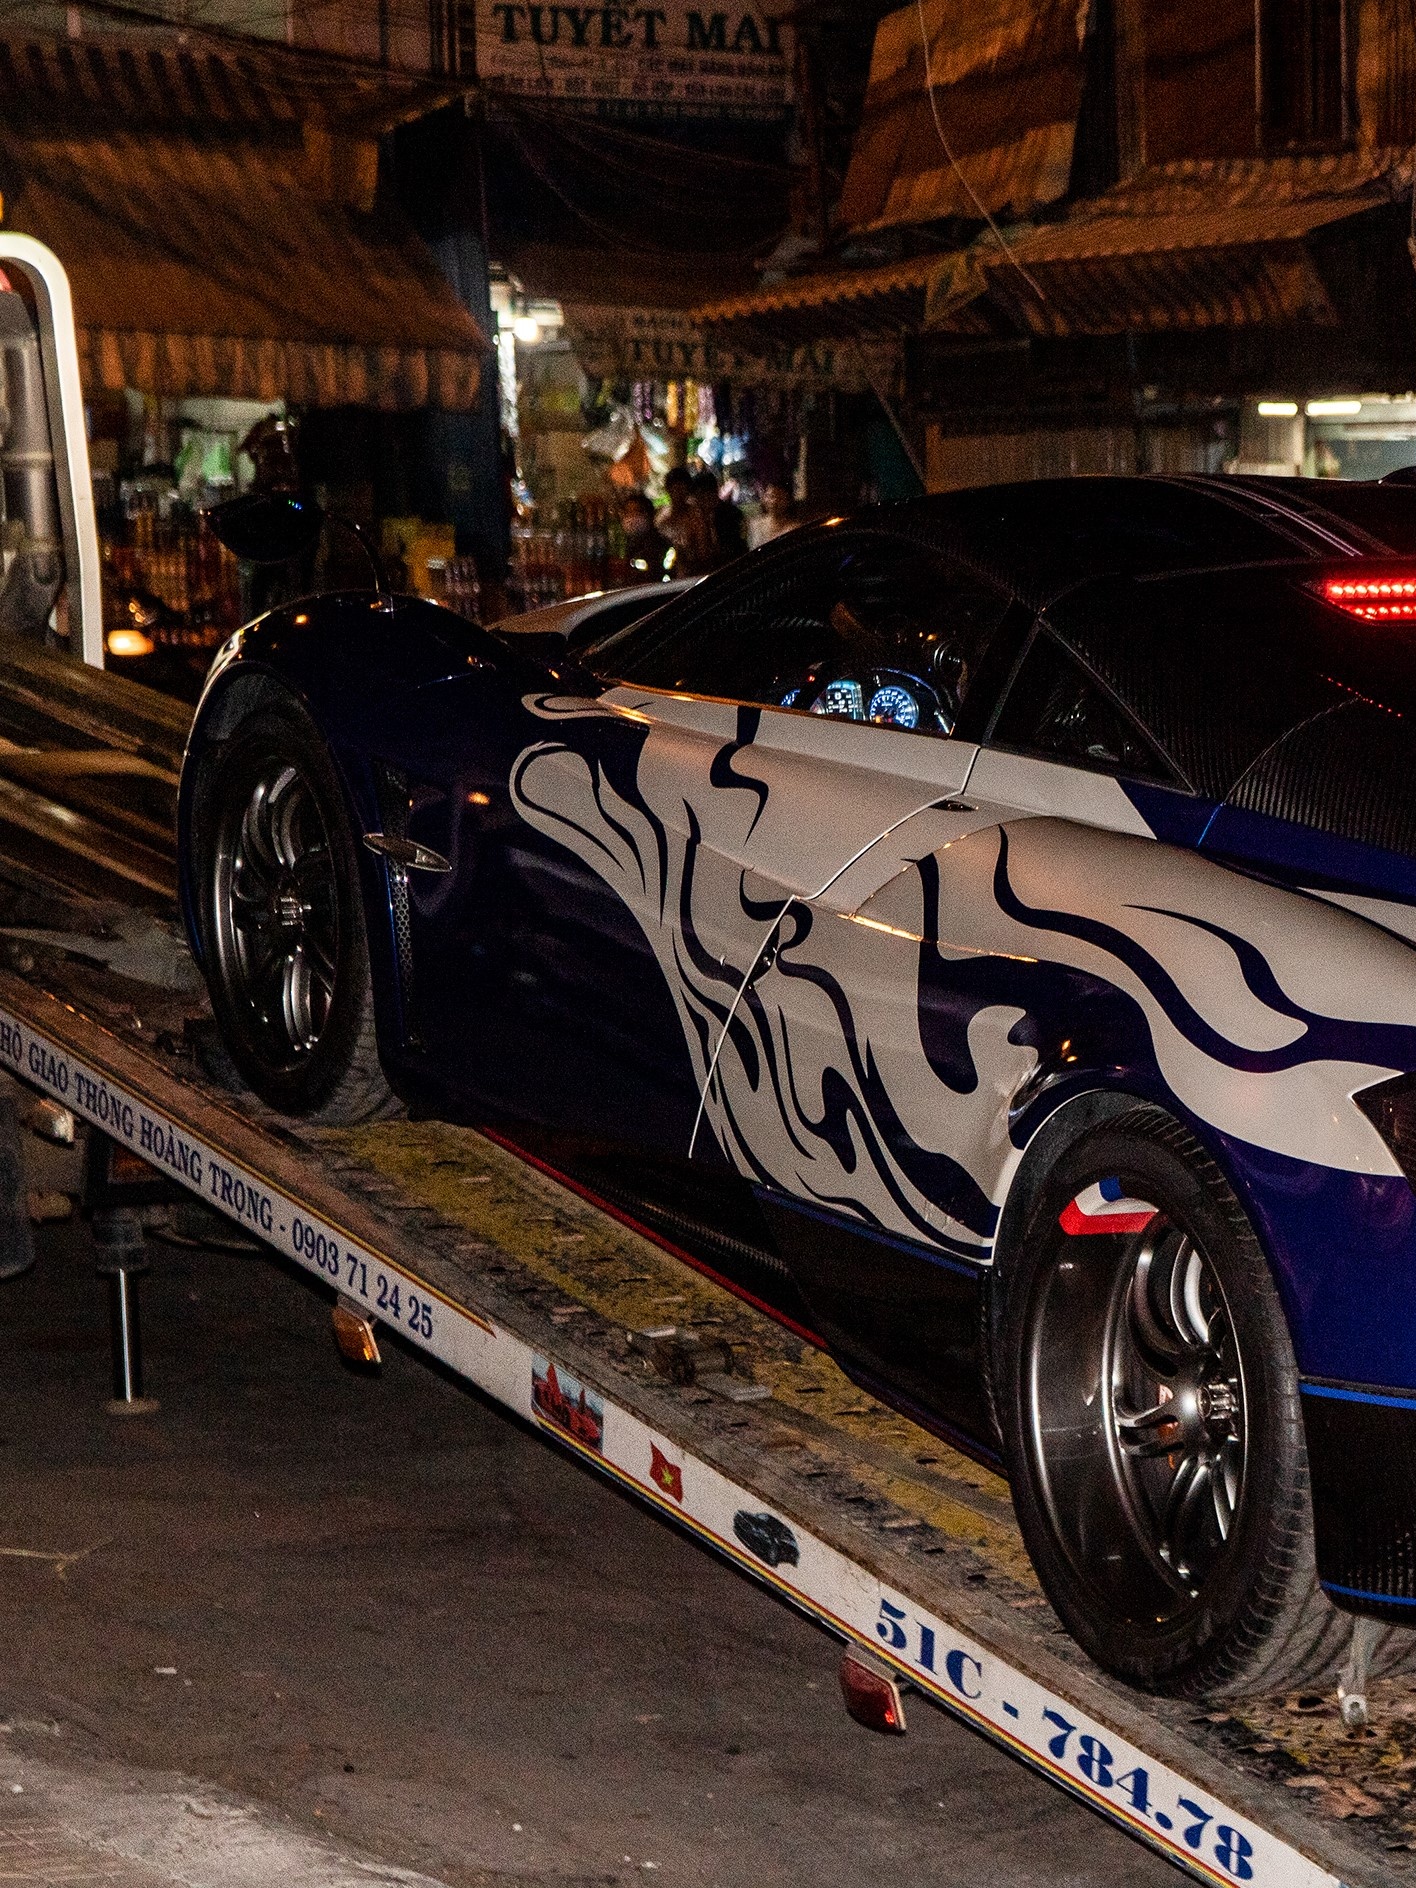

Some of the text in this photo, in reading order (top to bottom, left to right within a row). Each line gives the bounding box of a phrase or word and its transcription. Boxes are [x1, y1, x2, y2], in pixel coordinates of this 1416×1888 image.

[685, 10, 784, 55] MAI
[28, 1042, 69, 1094] GIAO
[74, 1072, 134, 1140] THÔNG
[139, 1114, 203, 1185] HOÀNG
[208, 1160, 274, 1233] TRỌNG
[292, 1218, 340, 1276] 0903
[347, 1253, 369, 1298] 71
[377, 1275, 401, 1320] 24
[408, 1295, 433, 1340] 25
[875, 1599, 983, 1700] 51C
[1041, 1705, 1254, 1881] 784.78
